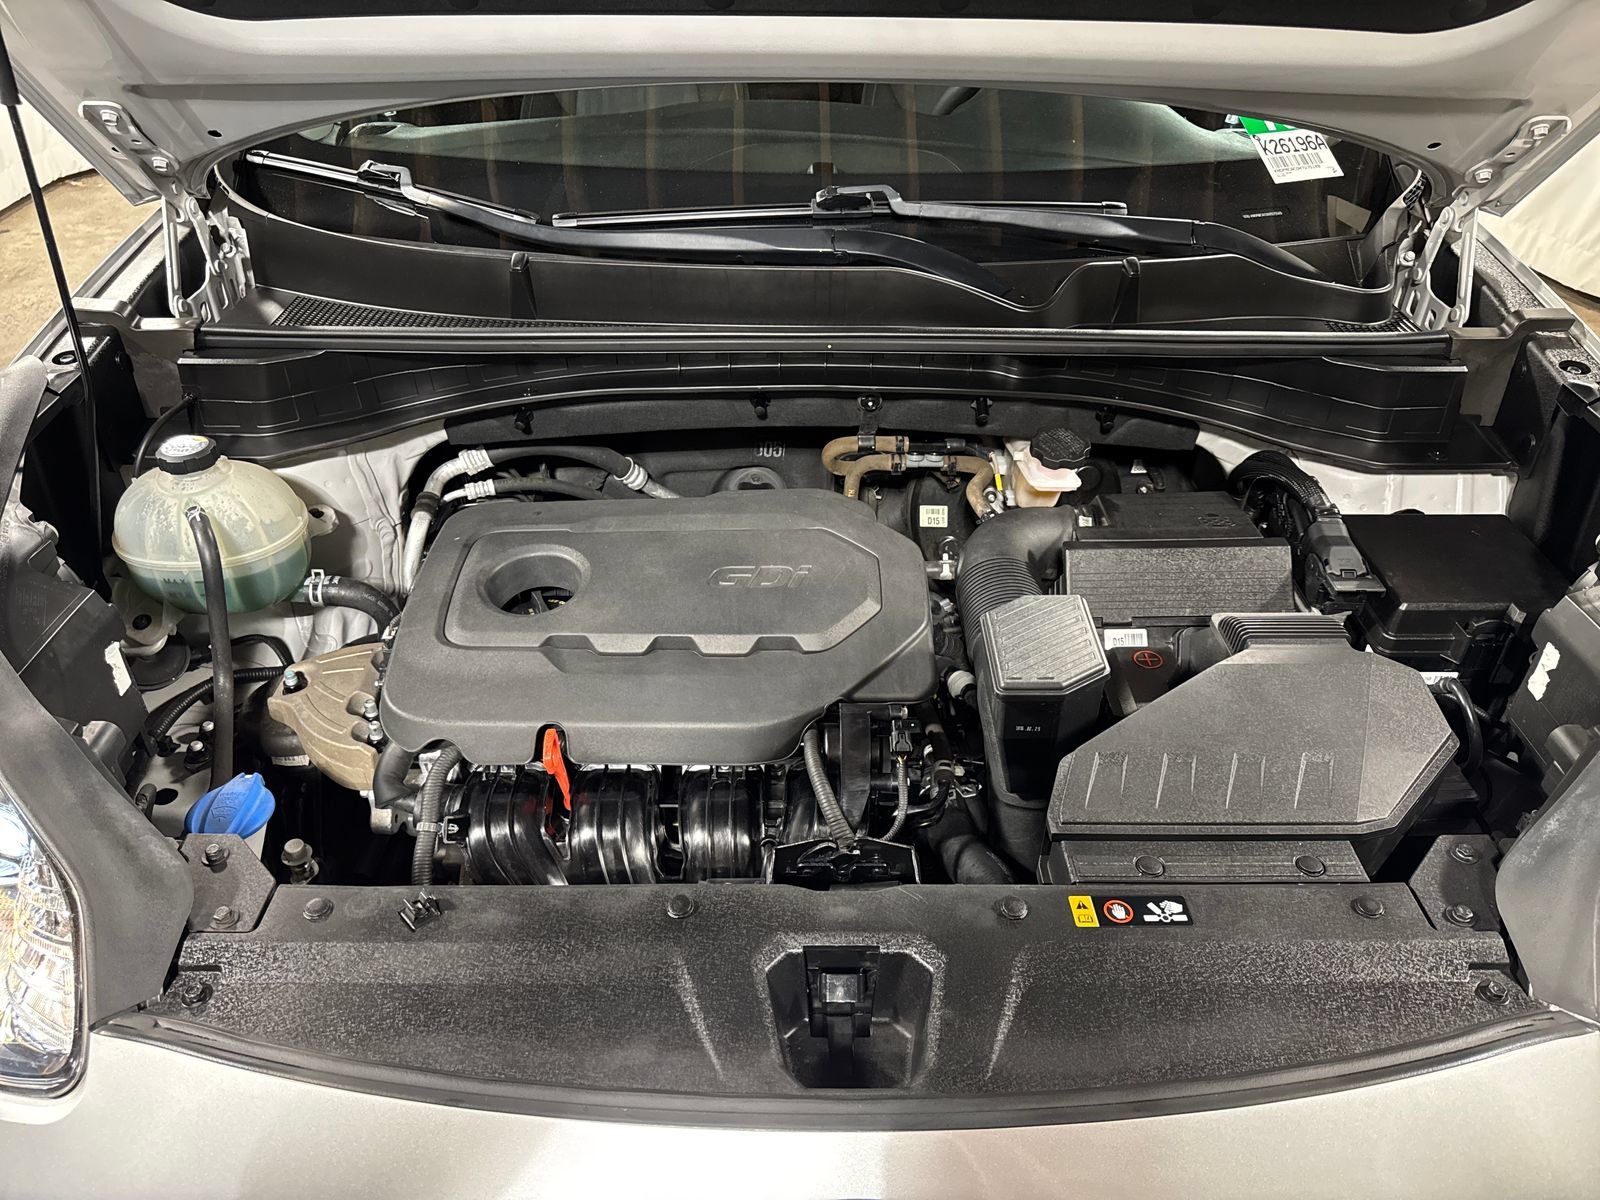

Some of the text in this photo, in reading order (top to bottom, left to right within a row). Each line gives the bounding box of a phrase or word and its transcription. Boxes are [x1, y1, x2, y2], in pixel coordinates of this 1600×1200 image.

[1259, 134, 1328, 156] K26196A
[927, 517, 940, 525] D15
[1112, 637, 1125, 646] D15
